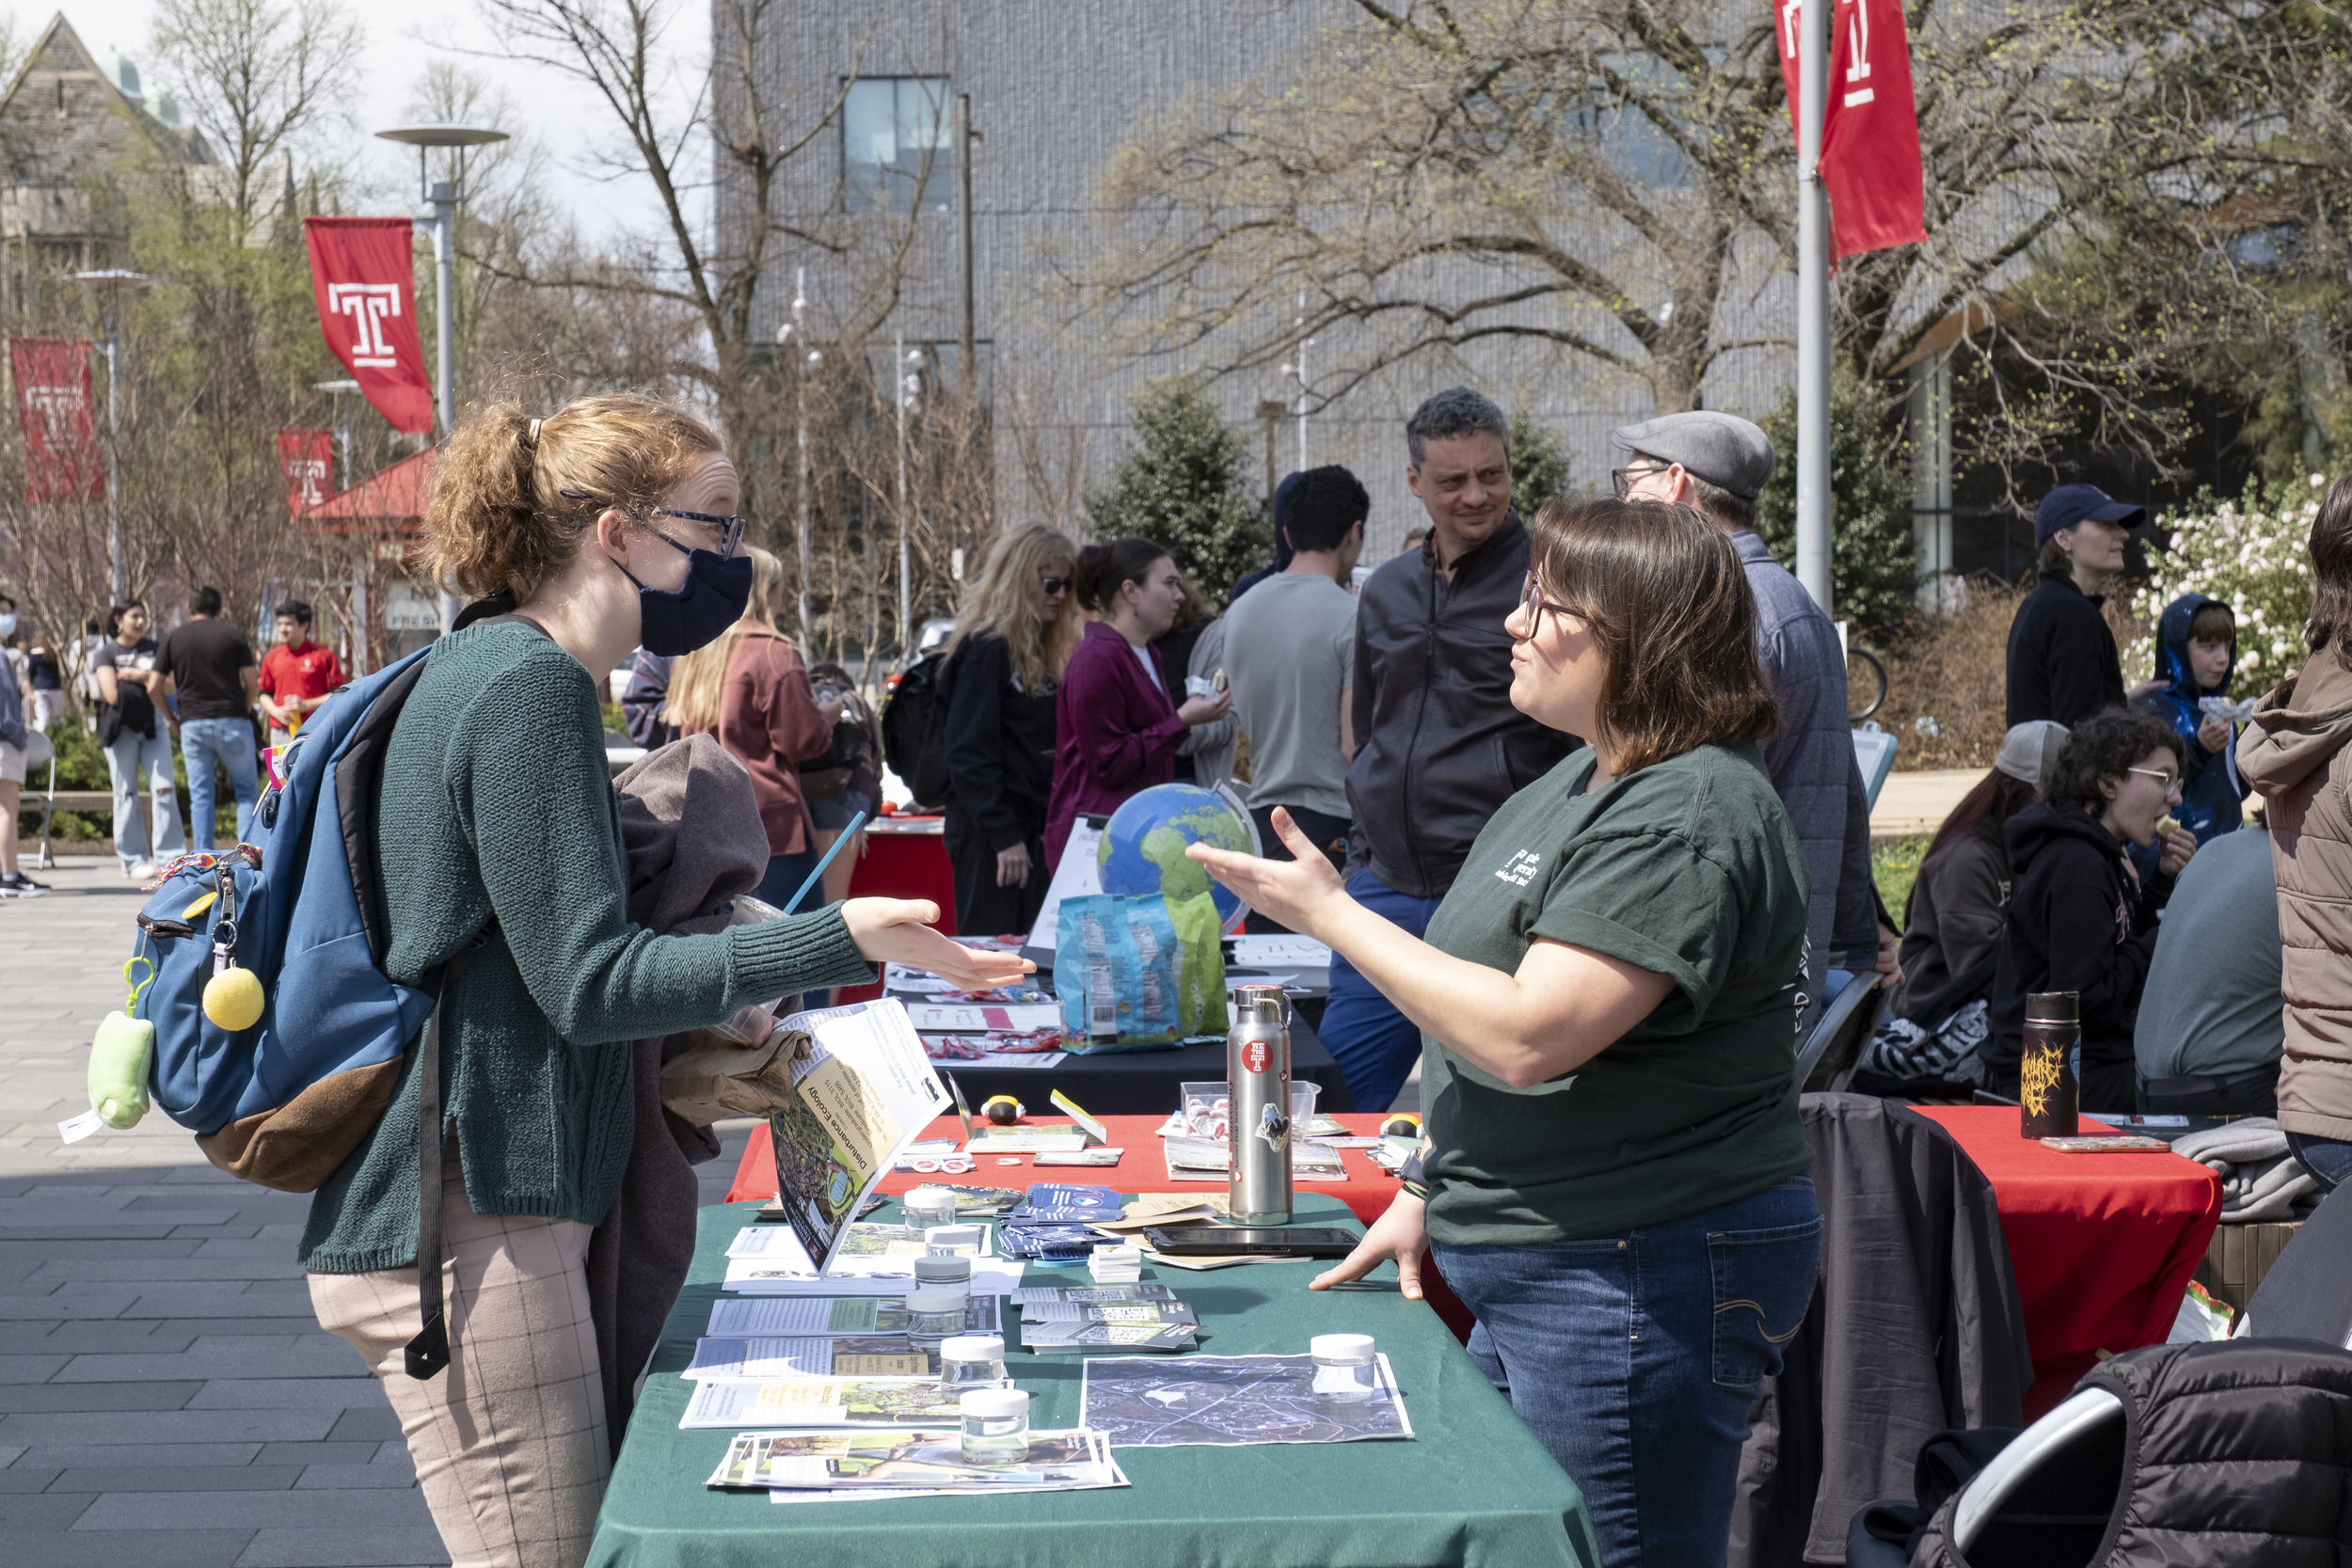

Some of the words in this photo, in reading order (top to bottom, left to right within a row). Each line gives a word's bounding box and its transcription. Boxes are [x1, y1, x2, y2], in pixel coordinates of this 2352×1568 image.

[328, 282, 401, 368] T
[25, 386, 84, 451] T
[288, 460, 326, 505] T
[1250, 1054, 1265, 1071] T
[806, 1086, 834, 1121] Ecology
[823, 1079, 834, 1094] 3115
[833, 1093, 845, 1108] BIOL
[844, 1094, 855, 1110] BIOL
[830, 1120, 867, 1170] Disturbance
[787, 1202, 812, 1242] University
[792, 1218, 809, 1247] Temple
